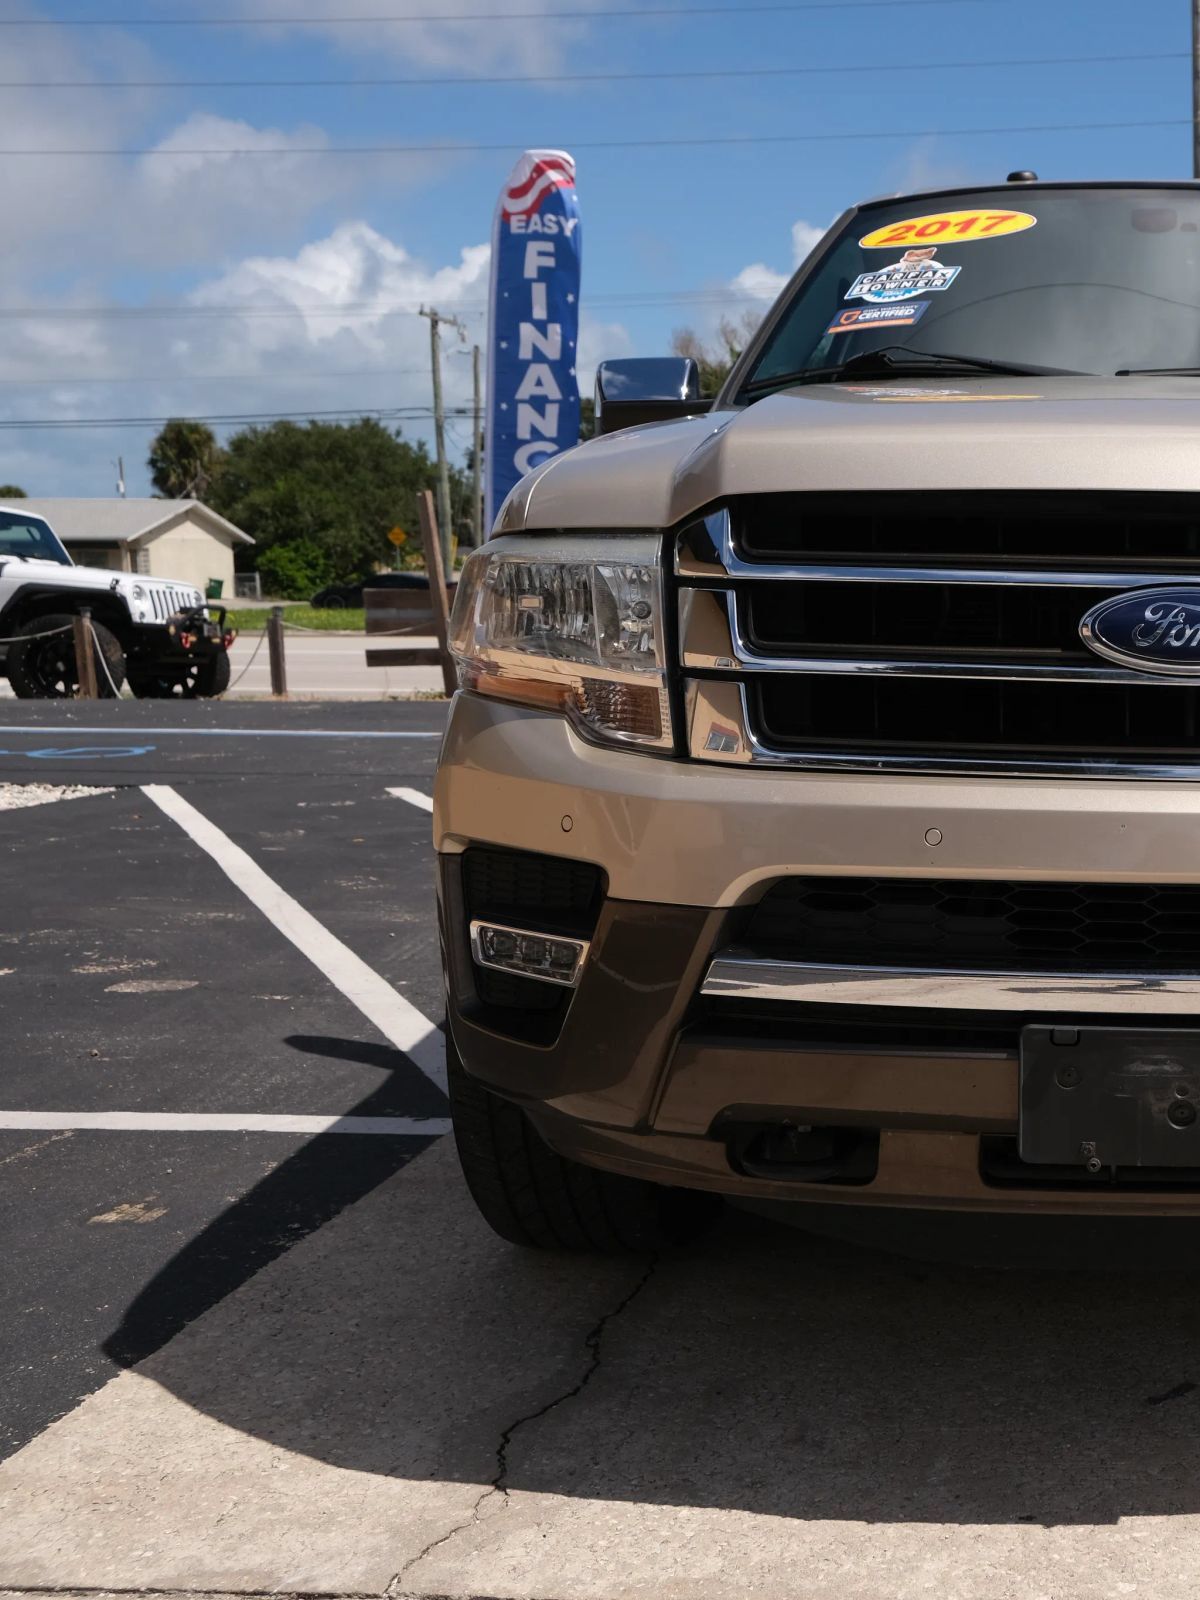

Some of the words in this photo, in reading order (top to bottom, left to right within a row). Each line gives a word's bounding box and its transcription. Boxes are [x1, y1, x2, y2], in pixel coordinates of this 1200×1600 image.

[510, 213, 578, 237] EASY
[874, 214, 1018, 246] 2017
[862, 271, 949, 284] CARFAX
[870, 279, 944, 291] OWNER
[858, 308, 915, 320] CERTIFIED
